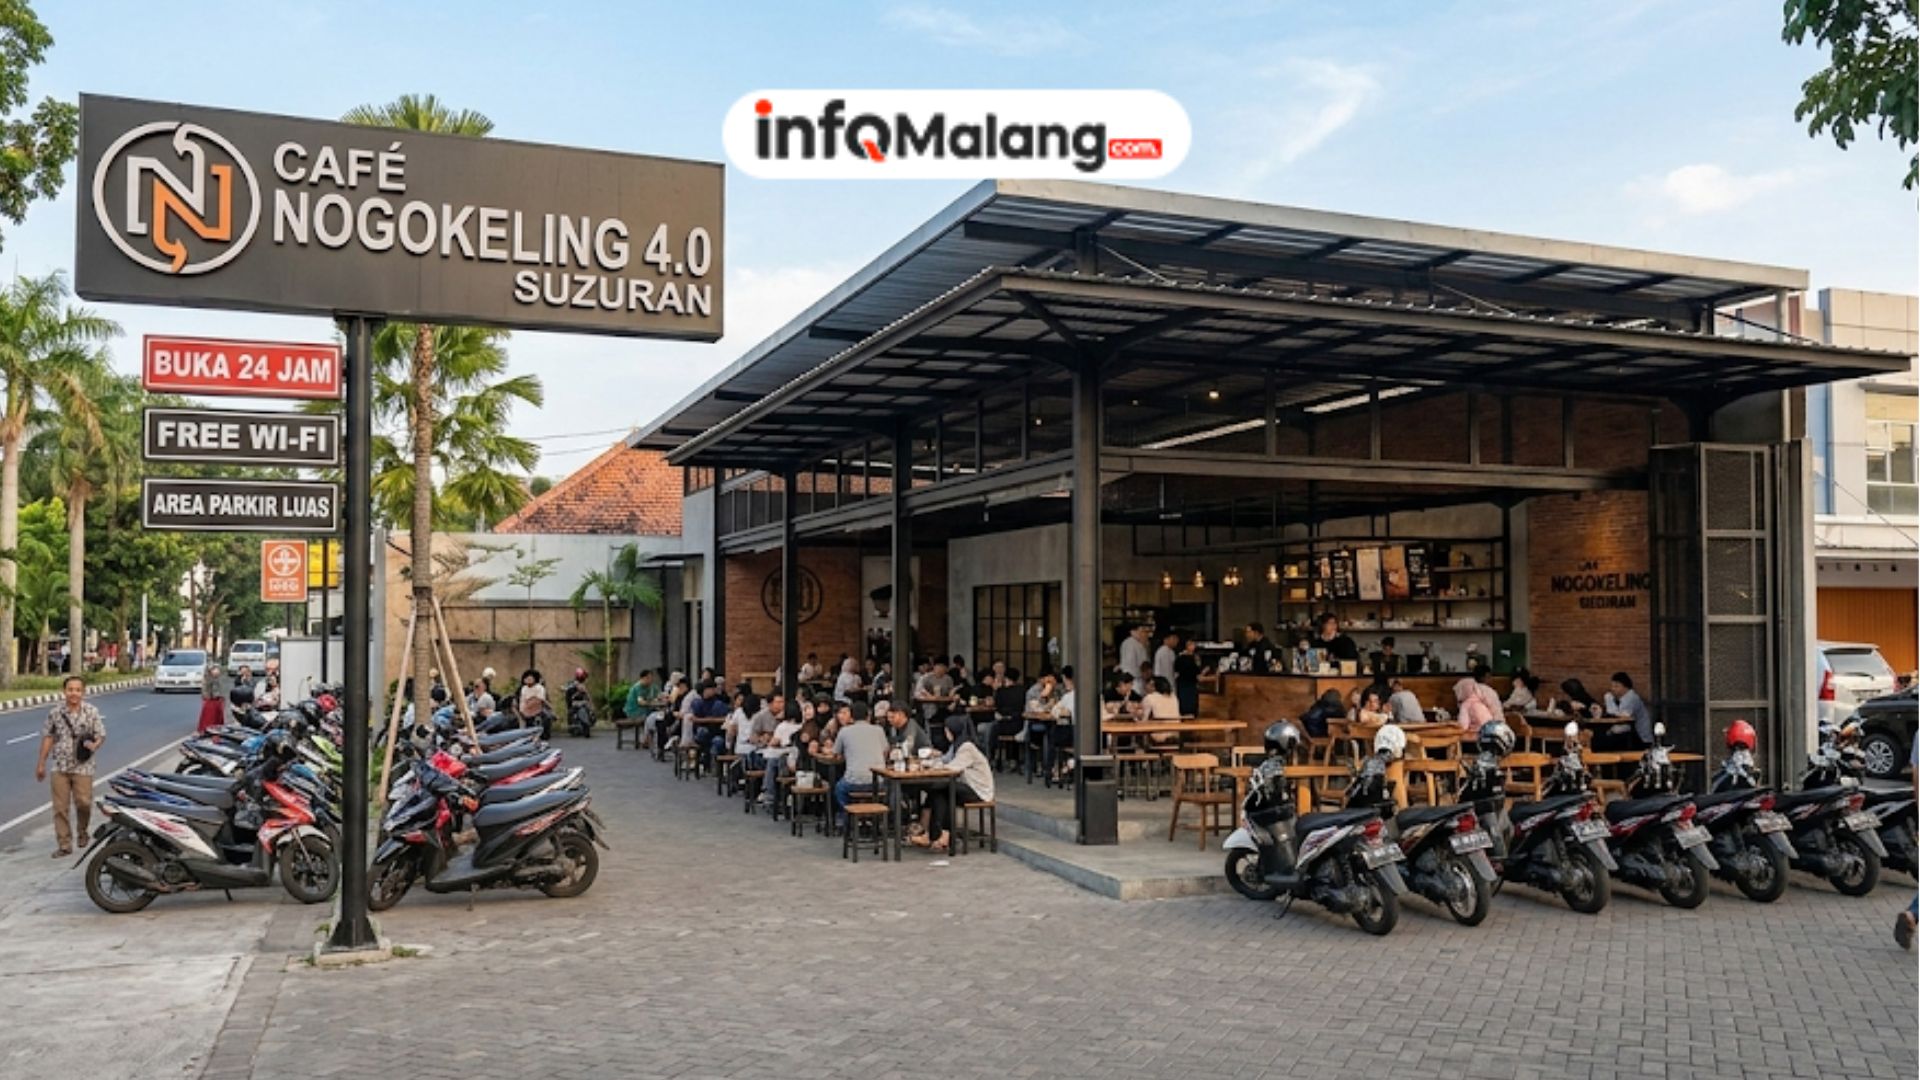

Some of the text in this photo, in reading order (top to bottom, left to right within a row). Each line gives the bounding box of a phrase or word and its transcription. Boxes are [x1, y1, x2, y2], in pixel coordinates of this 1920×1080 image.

[273, 142, 407, 192] CAFÉ
[273, 189, 712, 277] NOGOKELING 4.0
[514, 270, 712, 316] SUZURAN
[154, 350, 332, 384] BUKA 24 JAM
[157, 421, 327, 452] FREE WI-FI
[153, 494, 331, 519] AREA PARKIR LUAS
